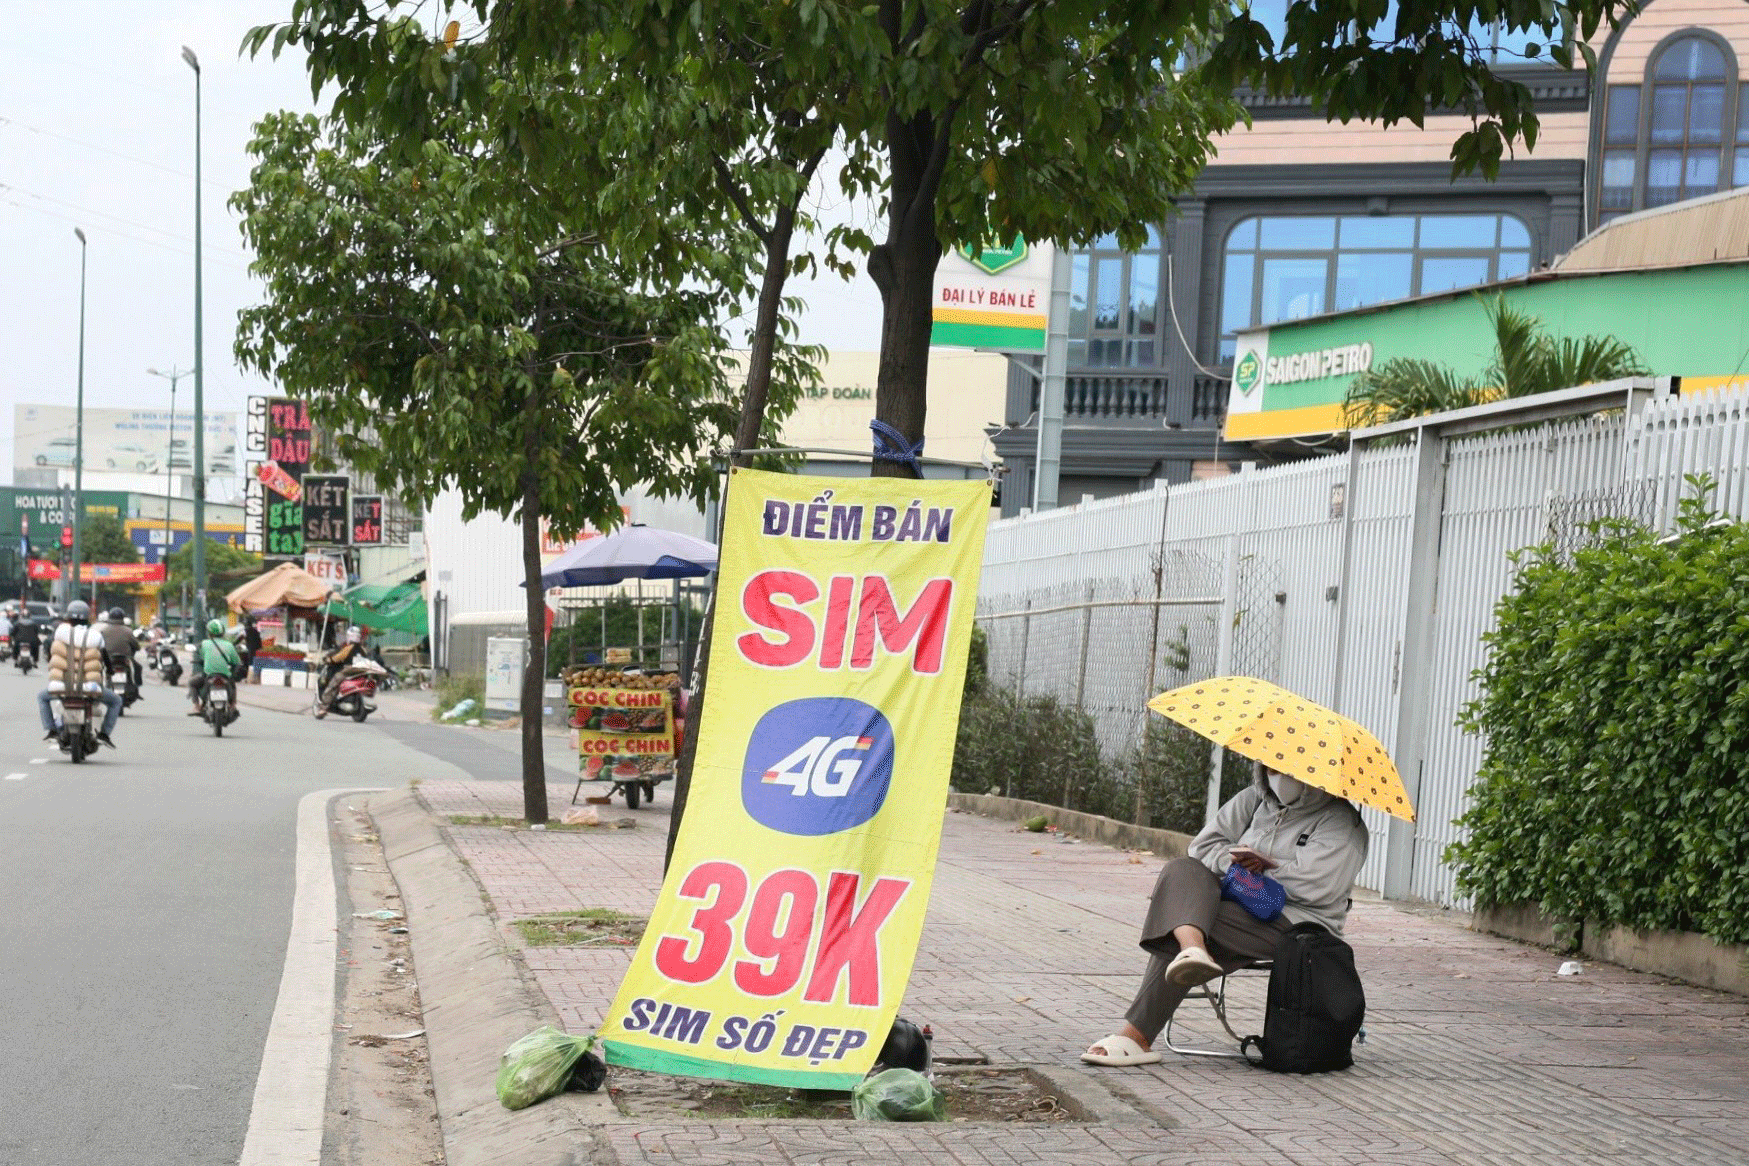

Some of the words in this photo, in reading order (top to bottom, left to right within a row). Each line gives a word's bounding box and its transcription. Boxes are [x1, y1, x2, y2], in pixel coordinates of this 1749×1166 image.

[942, 287, 964, 305] ĐẠI
[969, 287, 985, 304] LÝ
[990, 288, 1015, 307] BÁN
[1020, 288, 1036, 308] LẺ
[248, 396, 267, 450] CNC
[307, 510, 345, 540] SẮT
[763, 490, 862, 542] ĐIỂM
[871, 500, 954, 543] BÁN
[737, 569, 954, 674] SIM
[761, 735, 875, 797] 4G
[655, 861, 912, 1007] 39K
[623, 998, 711, 1044] SIM
[716, 1010, 786, 1053] SỐ
[781, 1024, 868, 1066] ĐẸP
